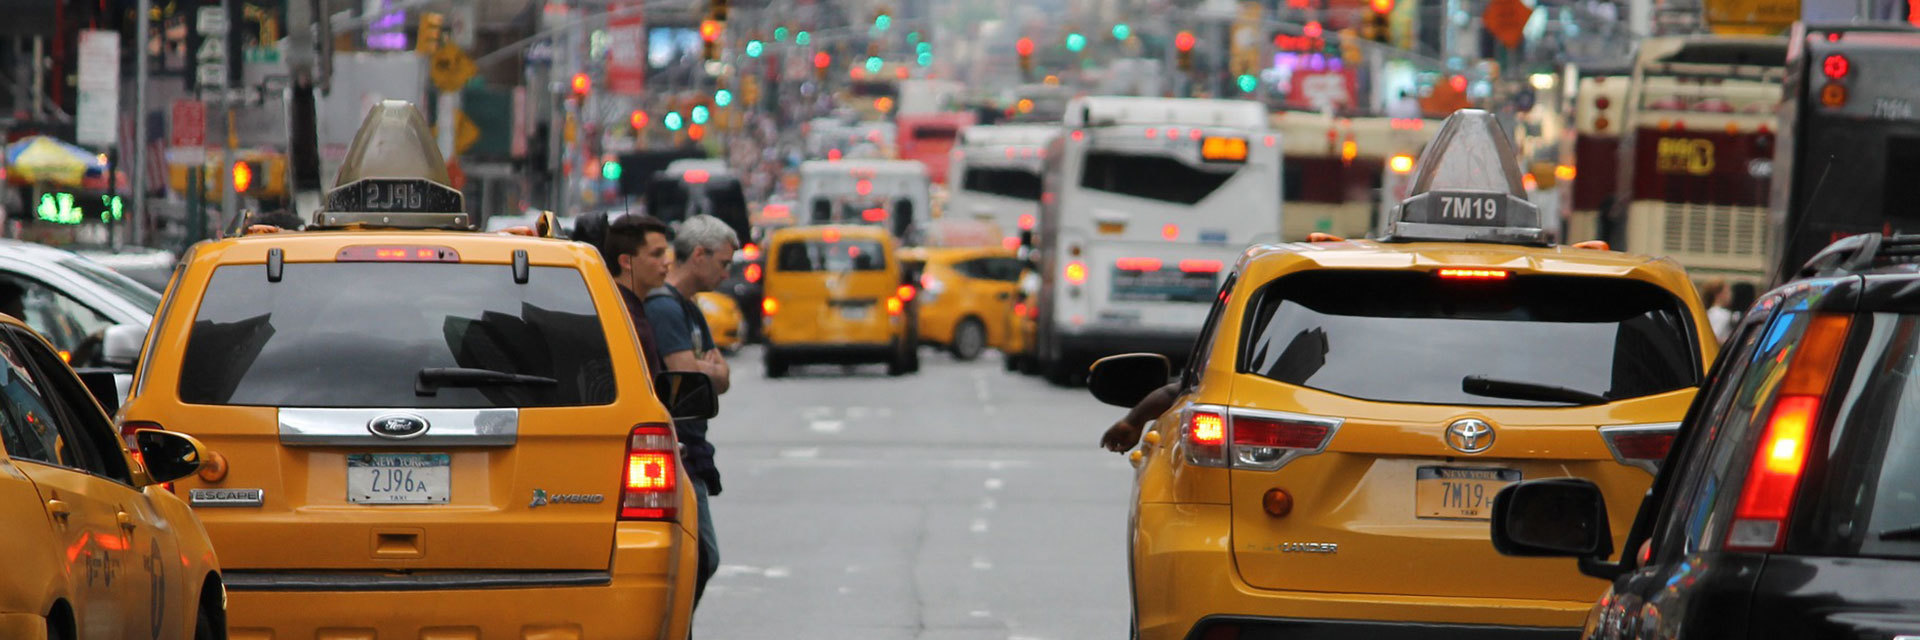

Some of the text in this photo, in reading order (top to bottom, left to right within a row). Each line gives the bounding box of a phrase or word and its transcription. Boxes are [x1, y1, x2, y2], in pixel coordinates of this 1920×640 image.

[366, 182, 421, 209] 2J96
[1440, 196, 1497, 219] 7M19
[385, 419, 412, 430] Ford
[373, 456, 425, 466] NEW YORK
[1442, 470, 1467, 479] NEW
[195, 490, 257, 500] ESCAPE
[549, 493, 605, 504] HYBRID
